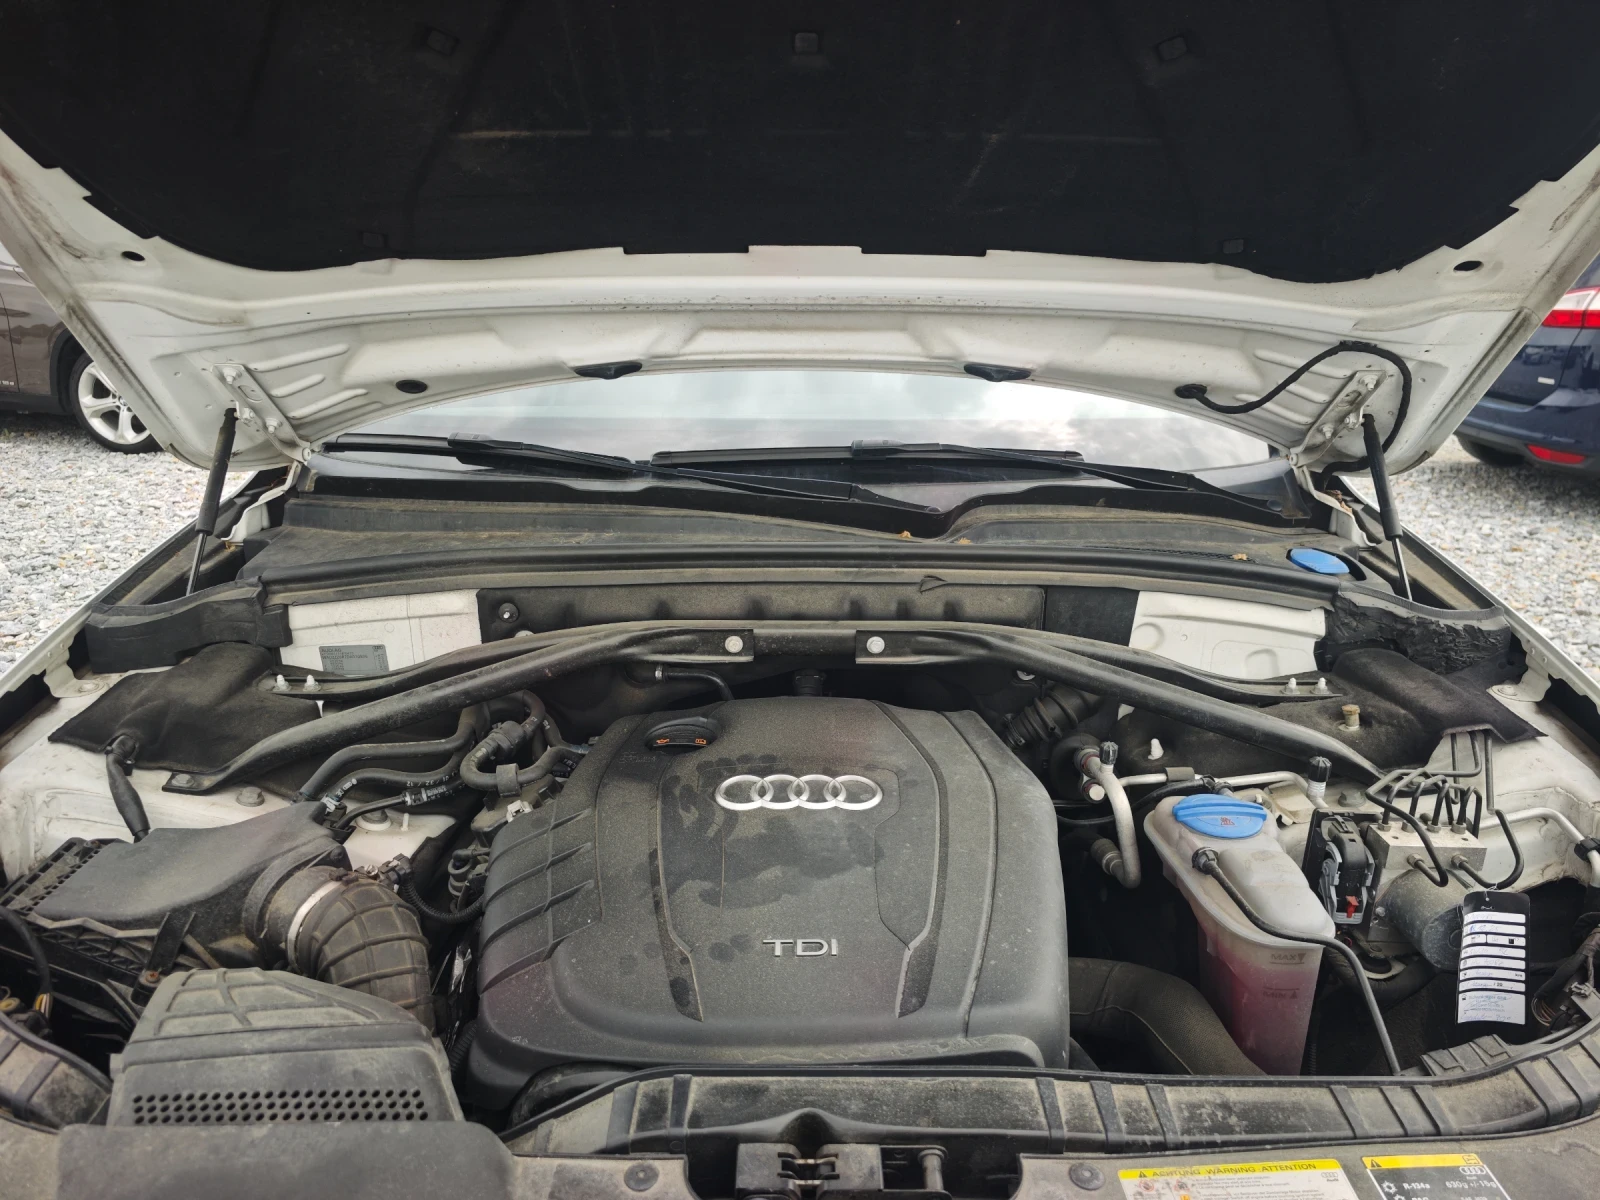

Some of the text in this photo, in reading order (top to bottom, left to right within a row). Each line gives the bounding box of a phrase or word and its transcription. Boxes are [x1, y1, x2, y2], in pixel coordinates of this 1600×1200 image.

[762, 938, 839, 958] TDI
[1271, 953, 1297, 961] MAX
[1263, 991, 1286, 999] MIN
[1205, 1166, 1256, 1175] WARNING
[1261, 1163, 1316, 1172] ATTENTION
[1402, 1182, 1431, 1190] R-134a
